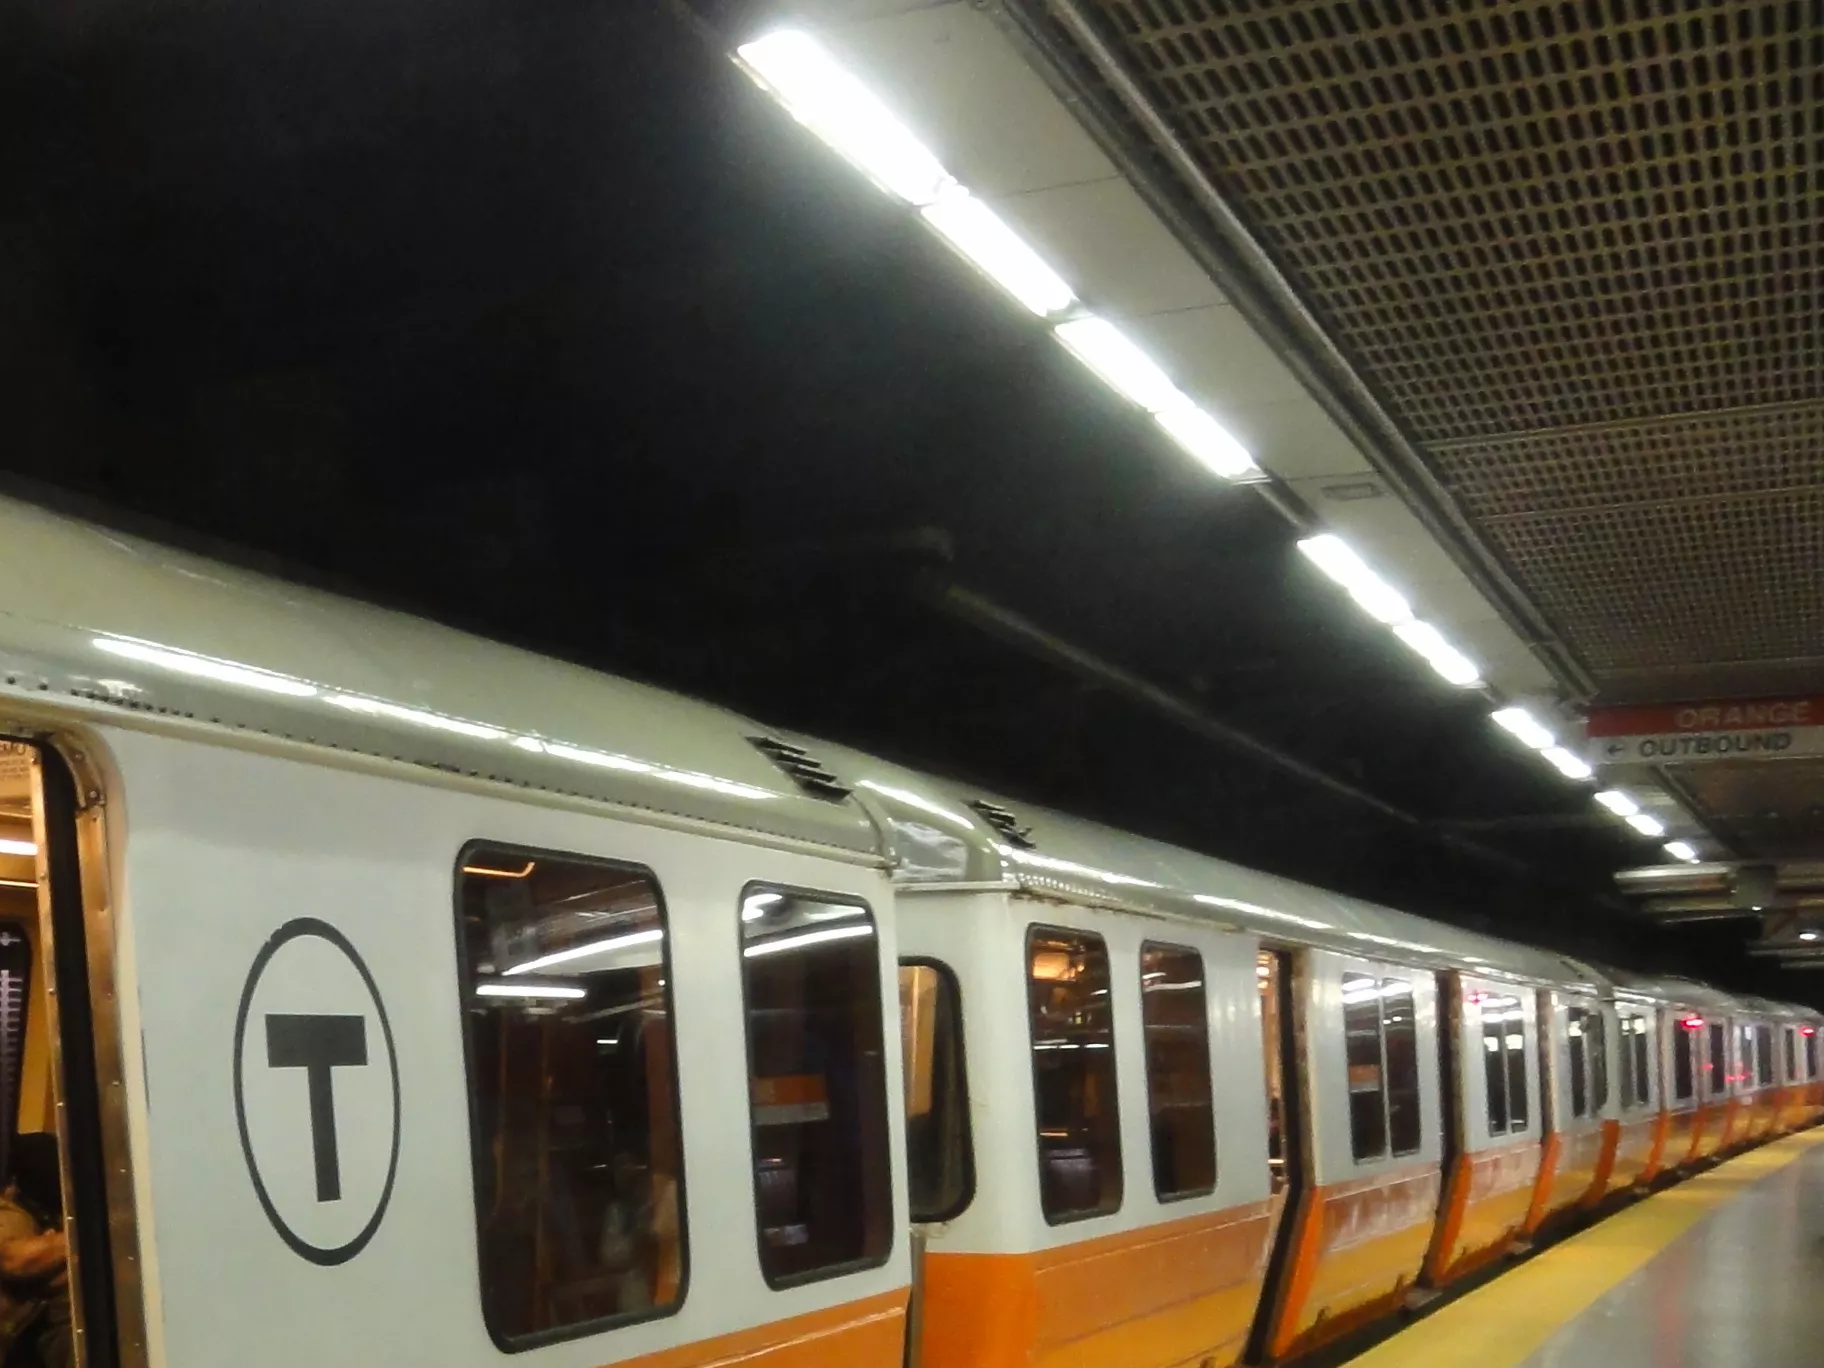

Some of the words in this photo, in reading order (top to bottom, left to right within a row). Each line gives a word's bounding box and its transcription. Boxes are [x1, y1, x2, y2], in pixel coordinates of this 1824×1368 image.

[1676, 700, 1812, 729] ORANGE
[1638, 731, 1792, 758] OUTBOUND
[265, 1013, 368, 1202] T
